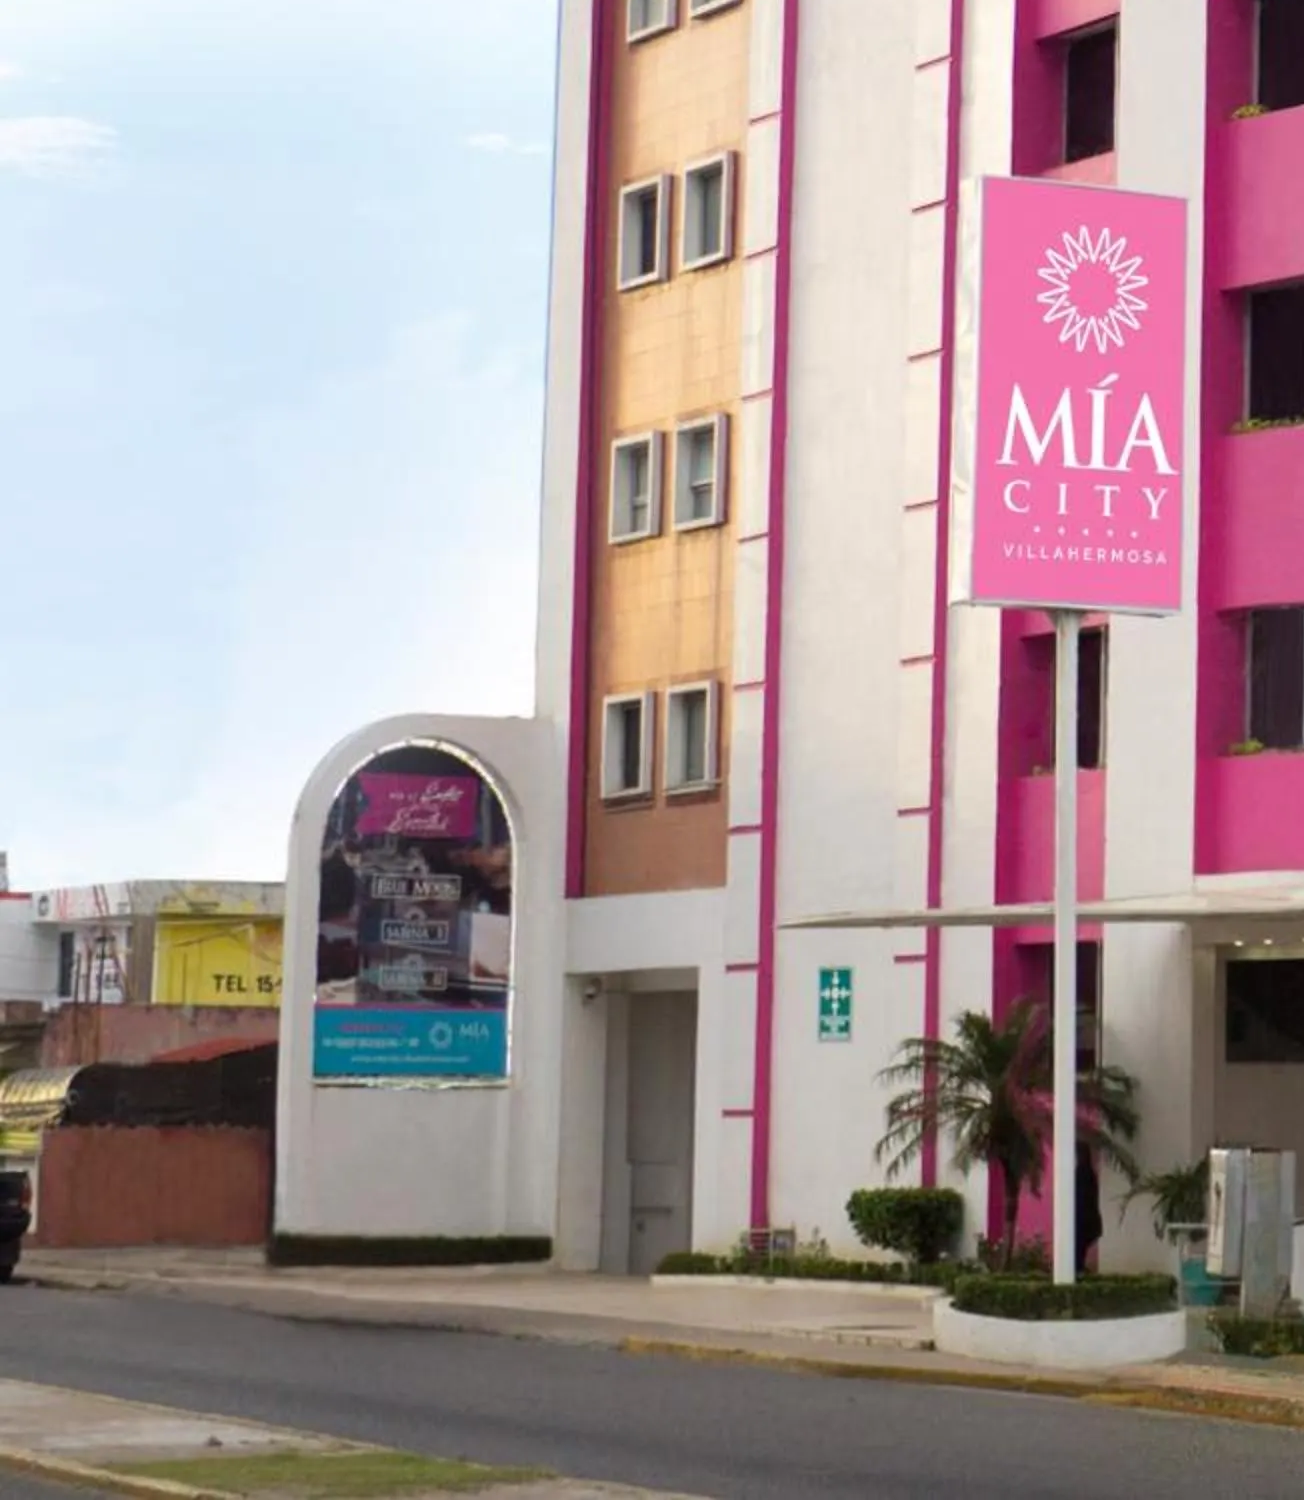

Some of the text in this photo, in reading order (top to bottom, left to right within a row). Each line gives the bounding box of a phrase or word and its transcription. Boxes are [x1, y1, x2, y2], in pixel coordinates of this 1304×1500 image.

[996, 373, 1179, 475] MÍA
[1004, 479, 1168, 520] CITY
[1004, 543, 1167, 565] VILLAHERMOSA
